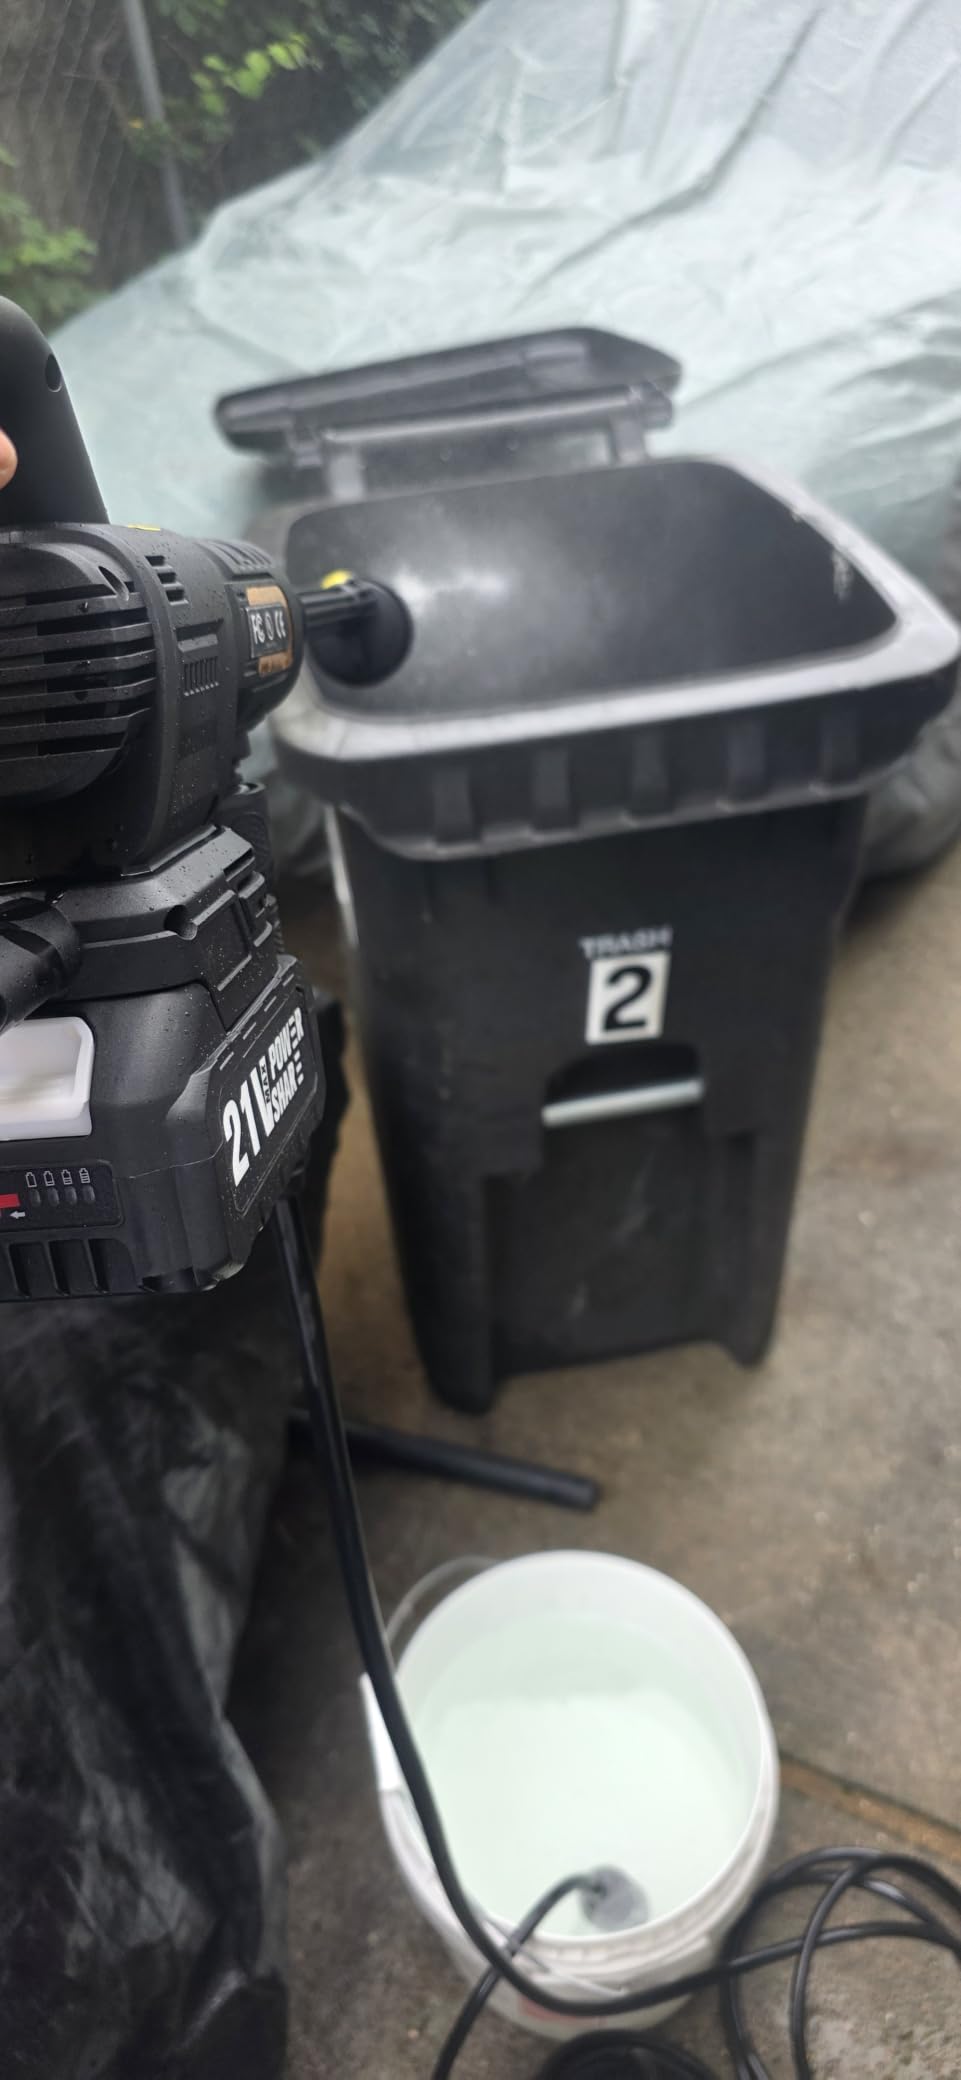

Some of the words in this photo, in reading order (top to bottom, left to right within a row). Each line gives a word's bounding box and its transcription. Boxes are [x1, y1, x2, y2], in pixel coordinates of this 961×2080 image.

[579, 926, 673, 959] TRASH
[604, 965, 652, 1031] 2
[268, 1007, 305, 1080] POWER
[223, 1056, 275, 1187] 21V
[271, 1050, 304, 1123] SHARE
